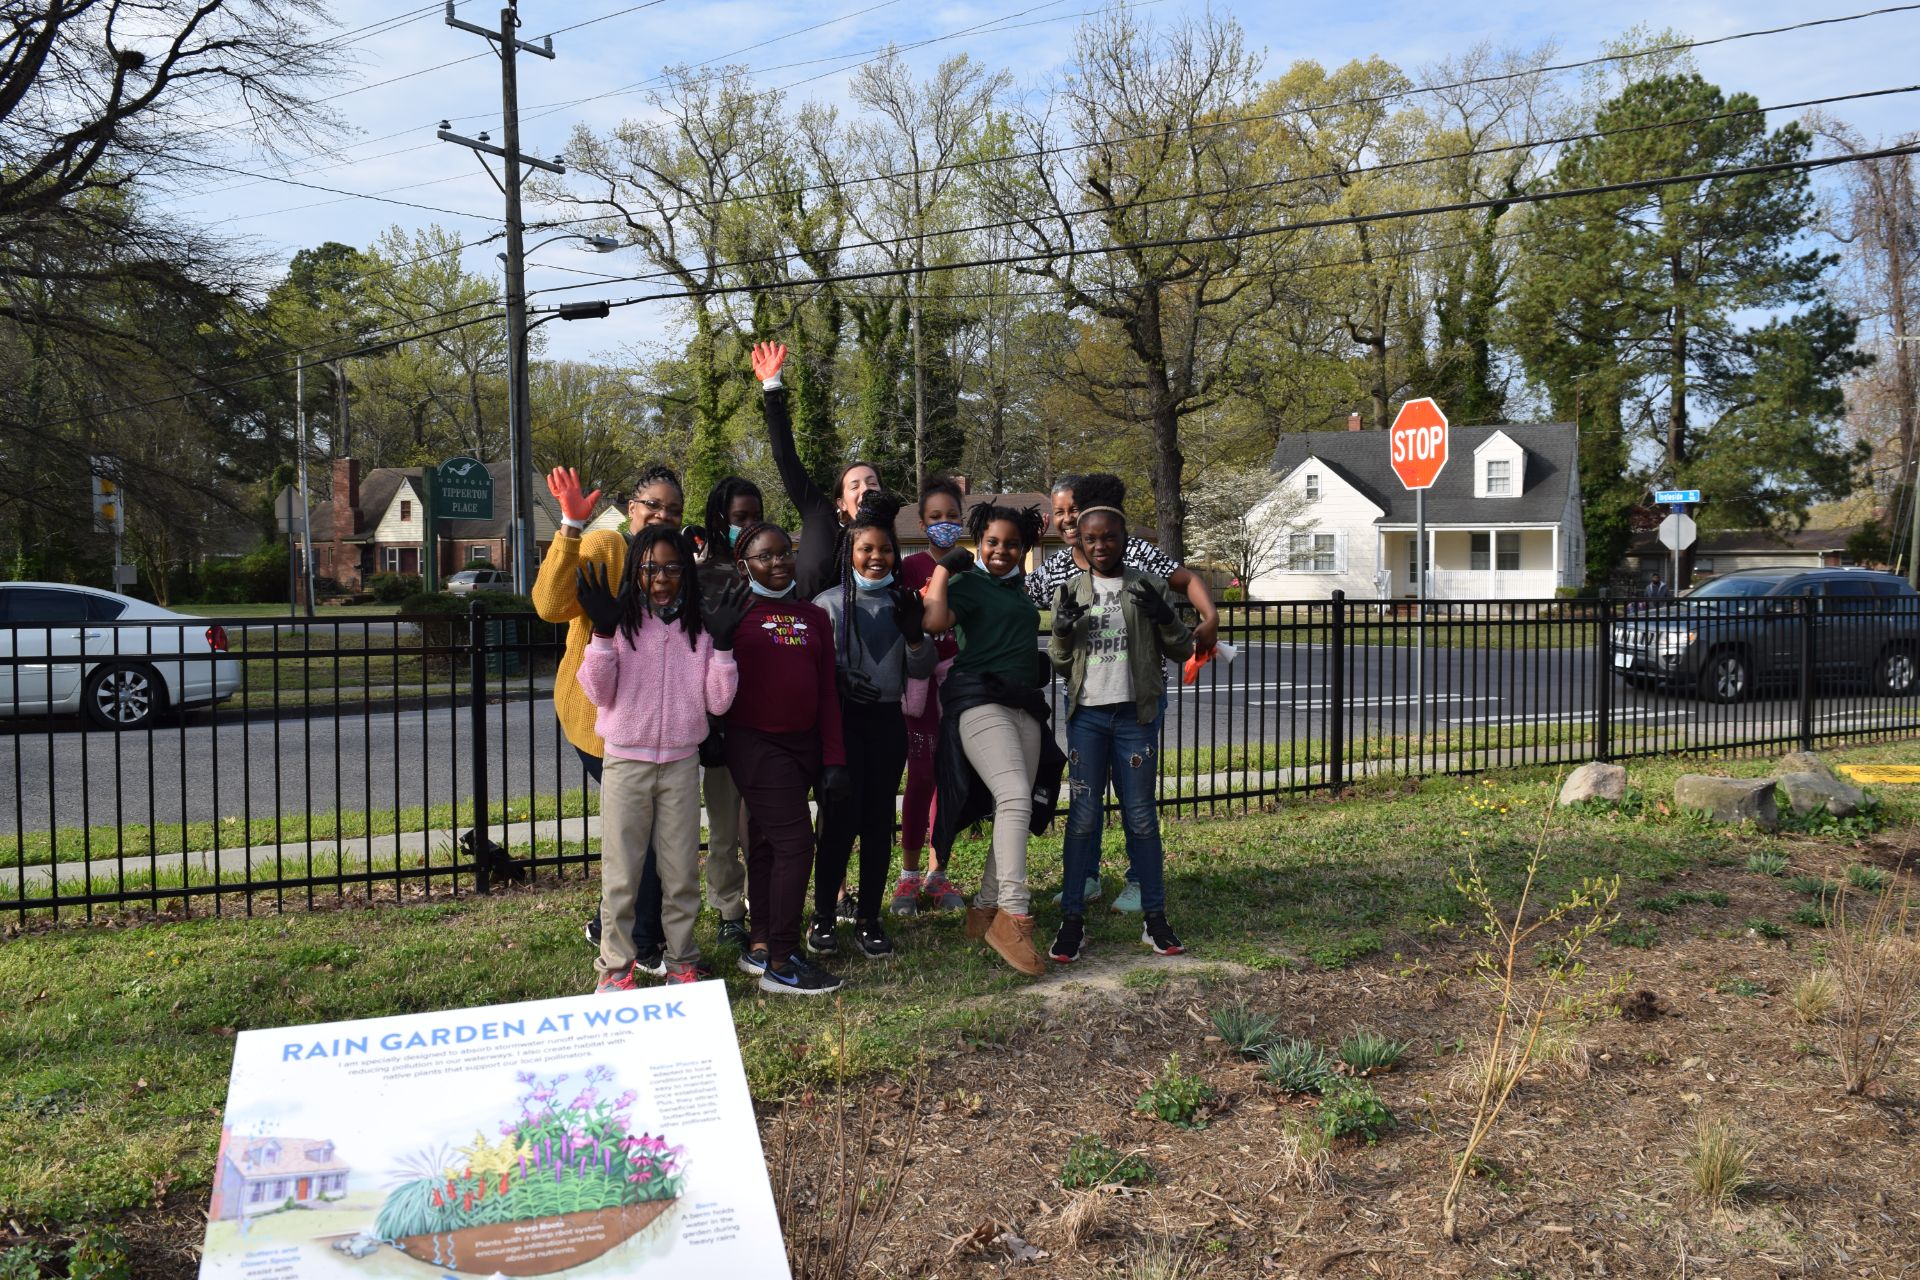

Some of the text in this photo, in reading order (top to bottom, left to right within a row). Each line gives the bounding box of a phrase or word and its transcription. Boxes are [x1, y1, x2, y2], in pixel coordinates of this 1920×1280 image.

[1394, 426, 1443, 462] STOP
[442, 488, 488, 499] TIPPERTON
[452, 502, 478, 512] PLACE
[766, 614, 800, 623] BELIEVE
[1088, 614, 1110, 630] BE
[773, 634, 807, 645] DREAMS
[776, 627, 798, 635] YOUR
[1086, 636, 1128, 656] OPPED
[282, 1000, 686, 1062] RAIN GARDEN AT WORK
[348, 1066, 390, 1076] reducing
[392, 1060, 432, 1071] pollution
[544, 1046, 572, 1054] create
[574, 1041, 605, 1050] habitat
[360, 1056, 401, 1066] specially
[404, 1051, 446, 1060] designed
[460, 1045, 492, 1055] absorb
[494, 1040, 544, 1050] stormwater
[548, 1036, 574, 1045] runoff
[577, 1033, 600, 1041] when
[383, 1072, 412, 1080] native
[414, 1069, 442, 1078] plants
[444, 1066, 463, 1074] that
[465, 1062, 500, 1072] support
[520, 1057, 542, 1065] local
[544, 1051, 593, 1062] pollinators.
[475, 1239, 502, 1248] Plants
[504, 1236, 522, 1245] with
[531, 1231, 554, 1241] deep
[574, 1224, 604, 1234] system
[514, 1222, 566, 1234] Deep Roots
[475, 1232, 606, 1258] encourage infiltration and help
[505, 1252, 536, 1262] absorb
